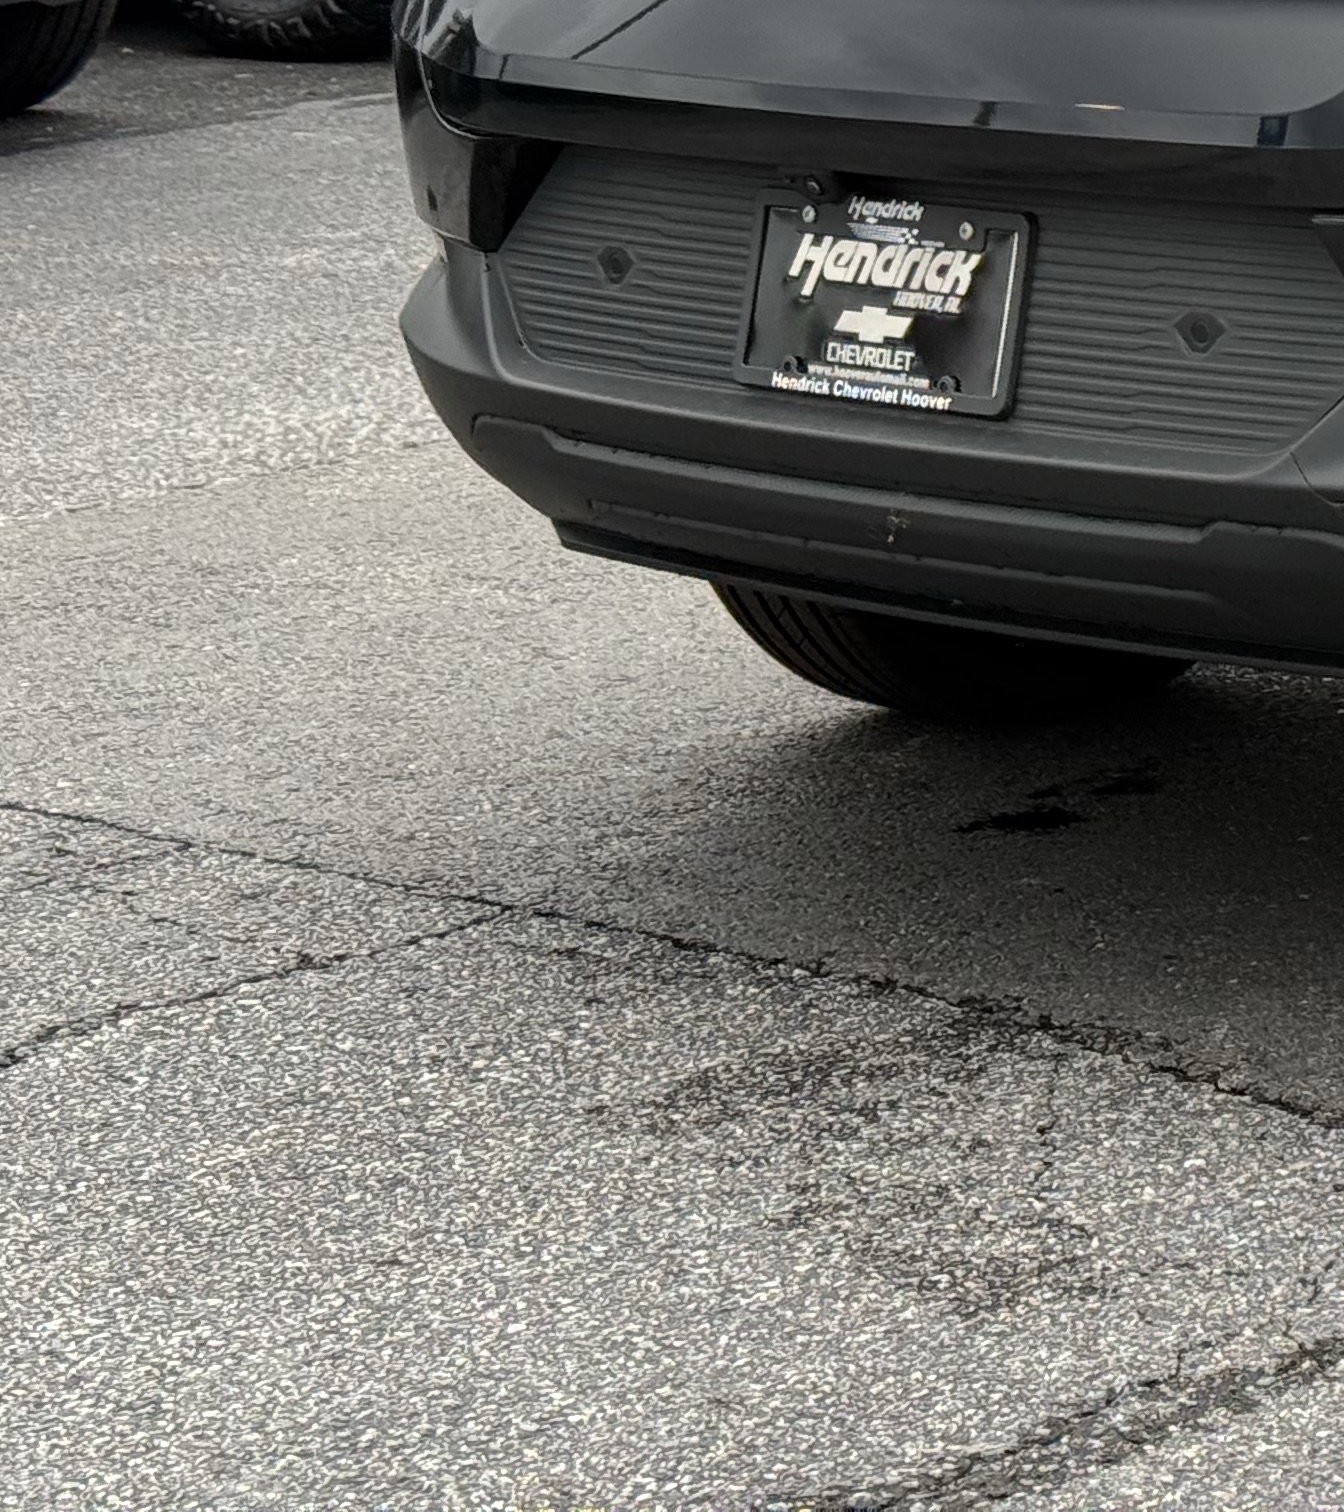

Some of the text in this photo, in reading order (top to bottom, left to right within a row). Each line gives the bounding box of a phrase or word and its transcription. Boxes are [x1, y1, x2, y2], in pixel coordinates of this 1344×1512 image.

[848, 195, 924, 222] Hendrick
[788, 233, 985, 296] Hendrick
[826, 341, 916, 372] CHEVROLET
[771, 370, 953, 411] Hendrick Chevrolet Hoover
